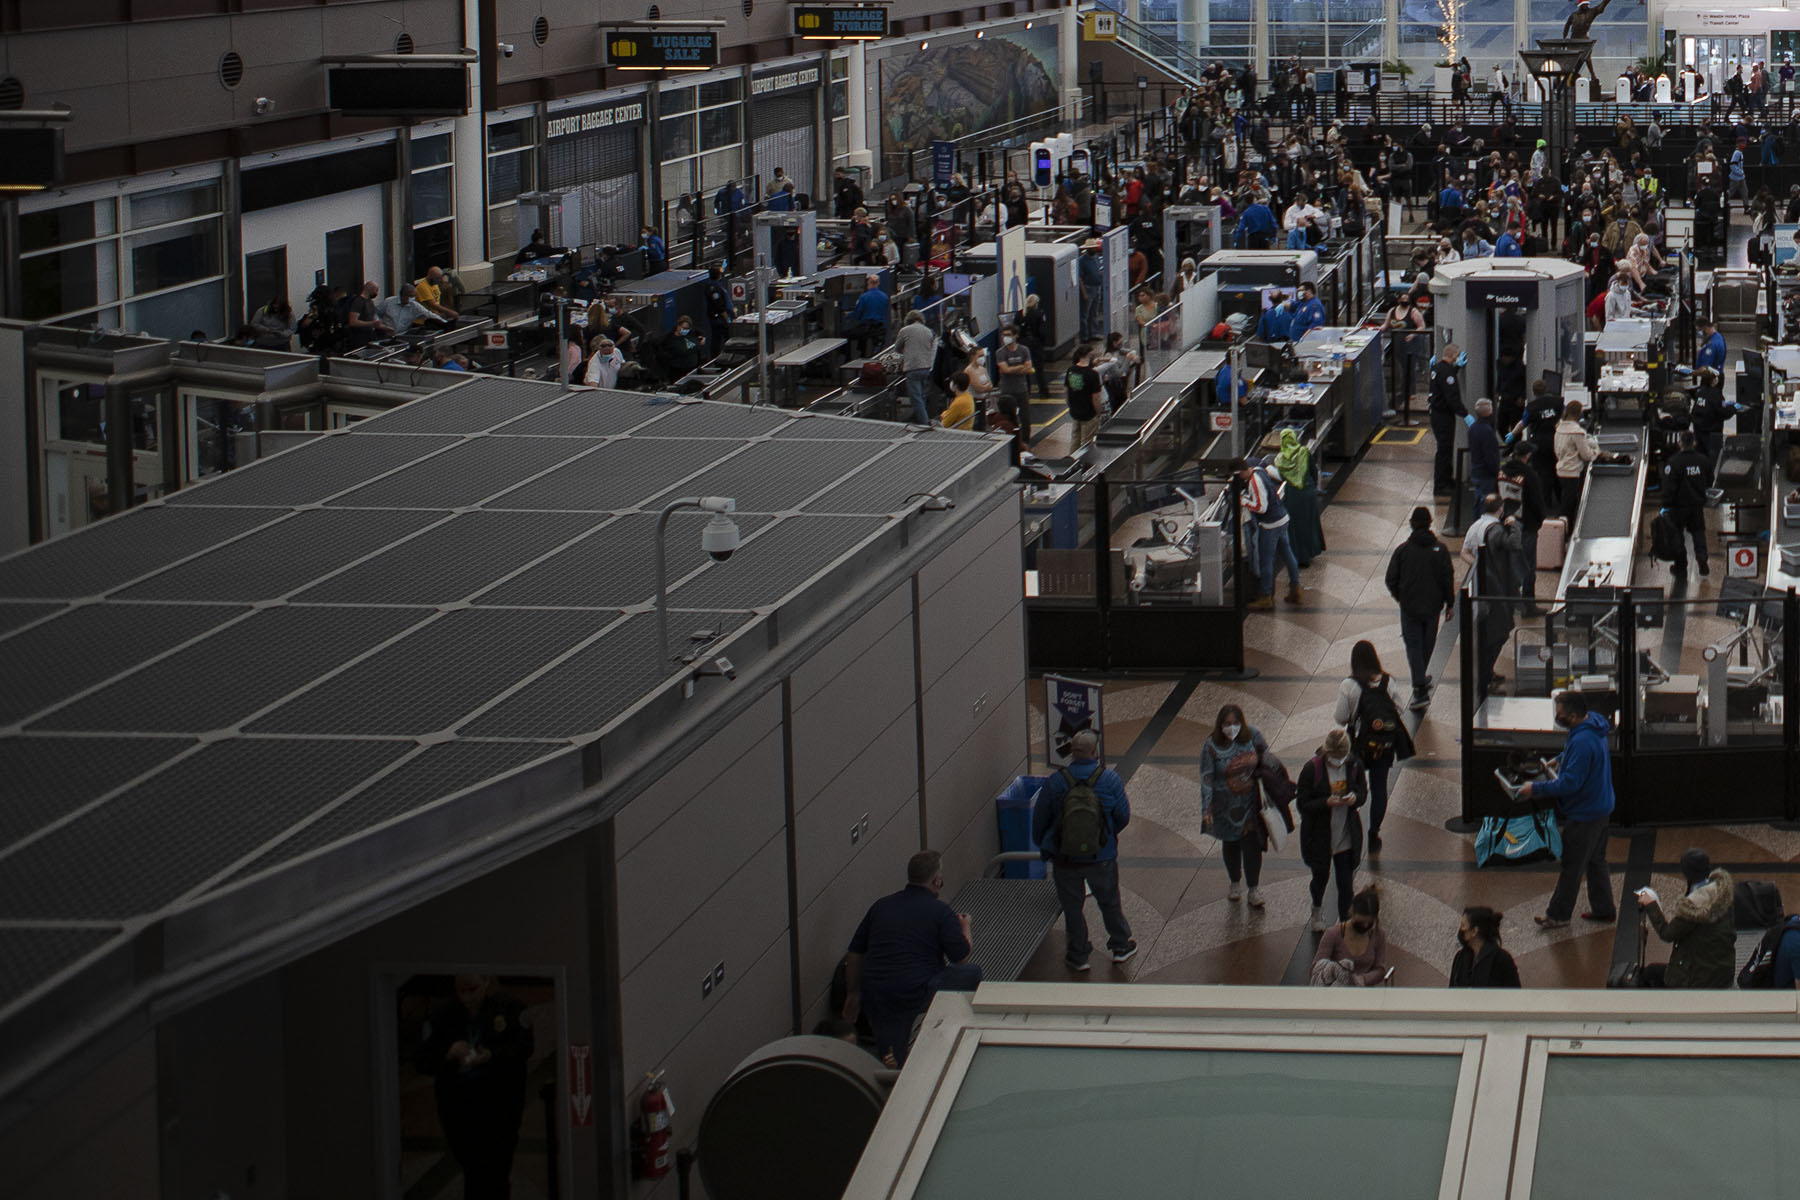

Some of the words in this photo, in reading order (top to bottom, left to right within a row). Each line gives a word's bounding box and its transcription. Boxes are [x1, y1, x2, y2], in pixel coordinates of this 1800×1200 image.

[833, 10, 884, 21] BAGGAGE
[833, 21, 884, 32] STORAGE
[653, 35, 712, 48] LUGGAGE
[665, 48, 701, 61] SALE
[775, 71, 799, 90] BAGGAGE
[798, 67, 819, 85] CENTER
[547, 115, 581, 139] AIRPORT
[581, 108, 615, 131] BAGGAGE
[615, 102, 643, 124] CENTER
[1495, 295, 1519, 303] leidos
[1686, 465, 1701, 476] TSA
